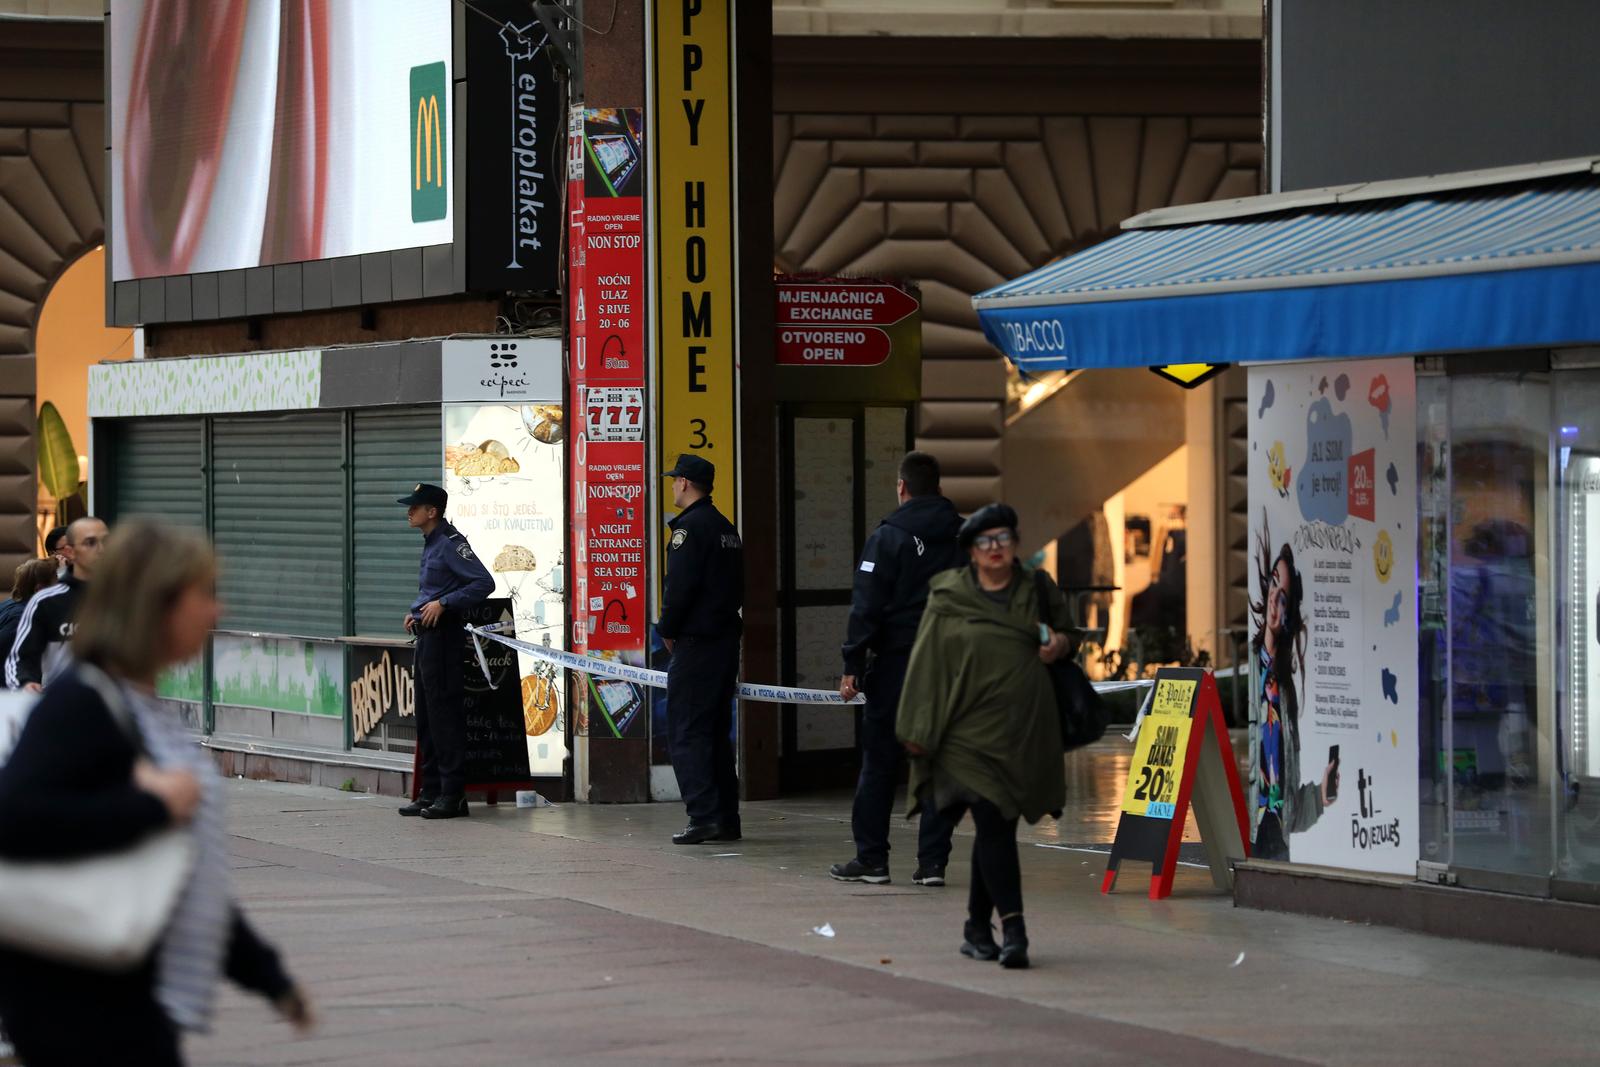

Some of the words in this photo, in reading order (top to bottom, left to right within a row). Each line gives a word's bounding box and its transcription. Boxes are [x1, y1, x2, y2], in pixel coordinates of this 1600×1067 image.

[511, 73, 545, 250] europlakat
[587, 214, 610, 222] RADNO
[610, 213, 641, 222] VRIJEME
[604, 222, 623, 231] OPEN
[587, 235, 612, 249] NON
[613, 235, 641, 249] STOP
[597, 272, 631, 286] NOĆNI
[681, 181, 713, 393] HOME
[600, 289, 629, 300] ULAZ
[778, 289, 886, 304] MJENJAČNICA
[598, 303, 605, 315] S
[606, 303, 631, 315] RIVE
[789, 307, 874, 321] EXCHANGE
[598, 317, 610, 329] 20
[618, 317, 630, 329] 06
[781, 331, 866, 344] OTVORENO
[802, 347, 845, 361] OPEN
[588, 463, 611, 472] RADNO
[611, 463, 642, 472] VRIJEME
[605, 472, 625, 481] OPEN
[588, 485, 613, 499] NON
[613, 485, 642, 499] STOP
[456, 503, 477, 518] ONO
[503, 518, 554, 532] KVALITETNO
[598, 523, 632, 535] NIGHT
[588, 538, 643, 549] ENTRANCE
[590, 552, 619, 563] FROM
[620, 552, 642, 563] THE
[593, 566, 613, 578] SEA
[614, 566, 638, 578] SIDE
[600, 581, 612, 592] 20
